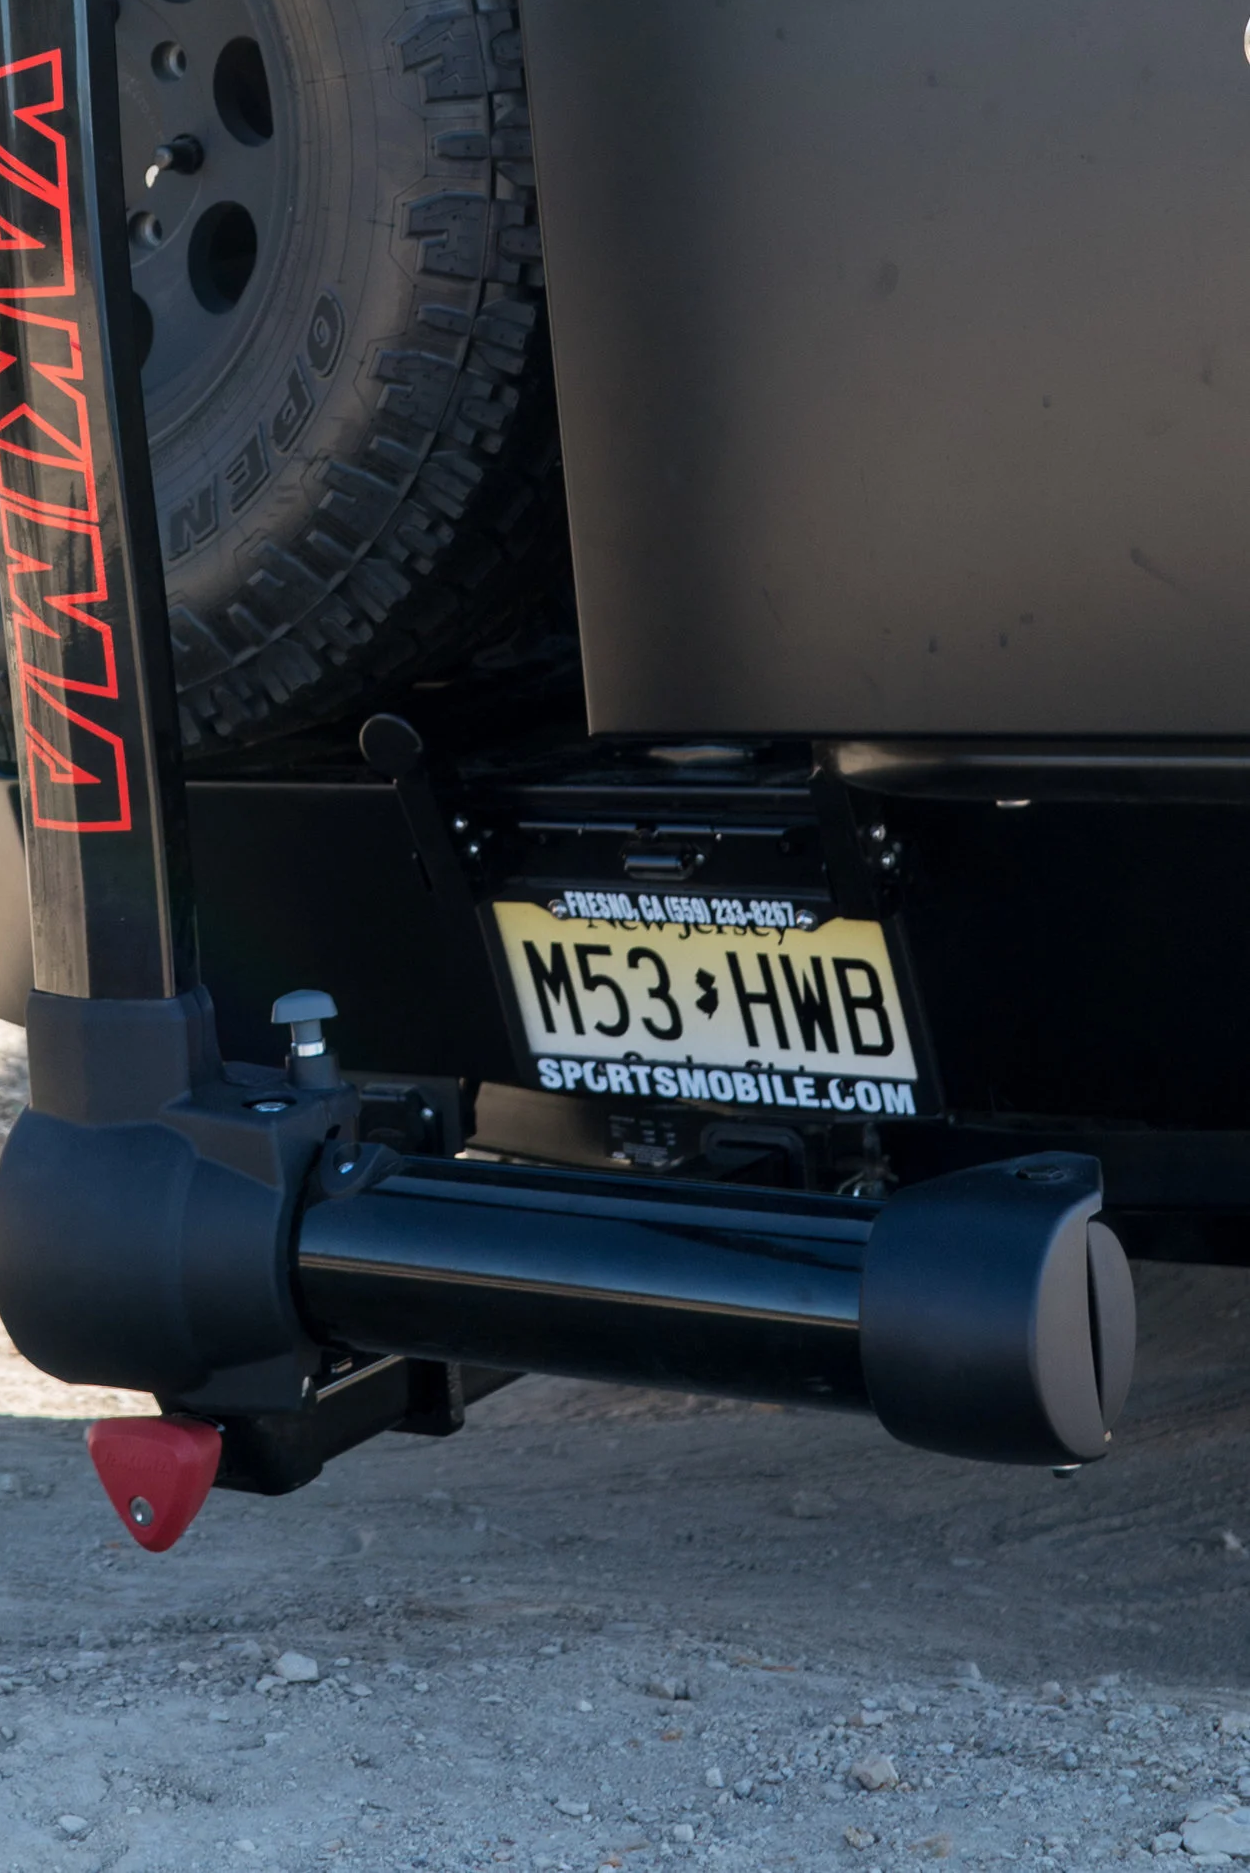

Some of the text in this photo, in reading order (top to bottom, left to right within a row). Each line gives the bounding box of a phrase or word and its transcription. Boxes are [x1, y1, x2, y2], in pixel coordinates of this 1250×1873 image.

[166, 286, 346, 563] OPEN
[563, 890, 796, 928] FRESNO, CA (559) 233-8267
[521, 939, 896, 1057] M53 HWB
[536, 1057, 917, 1116] SPORTSMOBILE.COM
